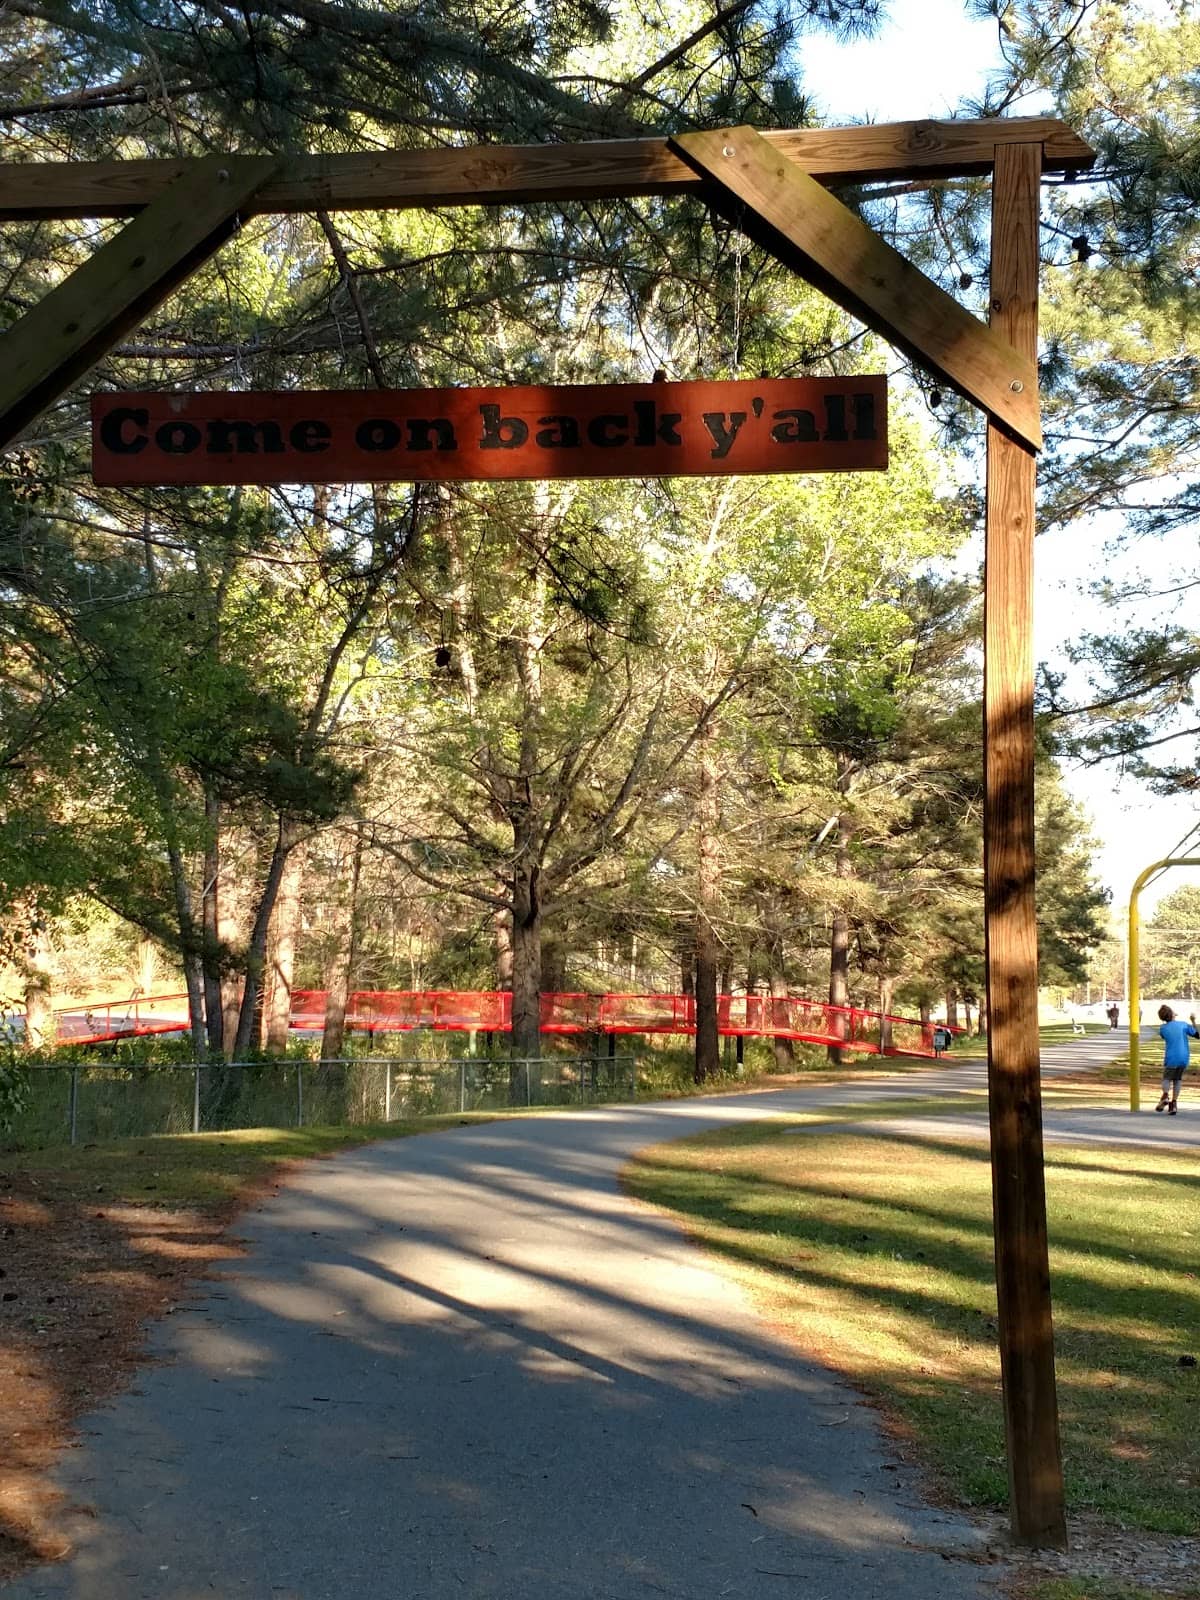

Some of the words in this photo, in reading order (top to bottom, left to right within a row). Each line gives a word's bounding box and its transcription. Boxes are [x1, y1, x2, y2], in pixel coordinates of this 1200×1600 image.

[101, 408, 332, 454] Come
[355, 418, 457, 451] on
[479, 400, 682, 449] back
[703, 393, 877, 459] y'all
